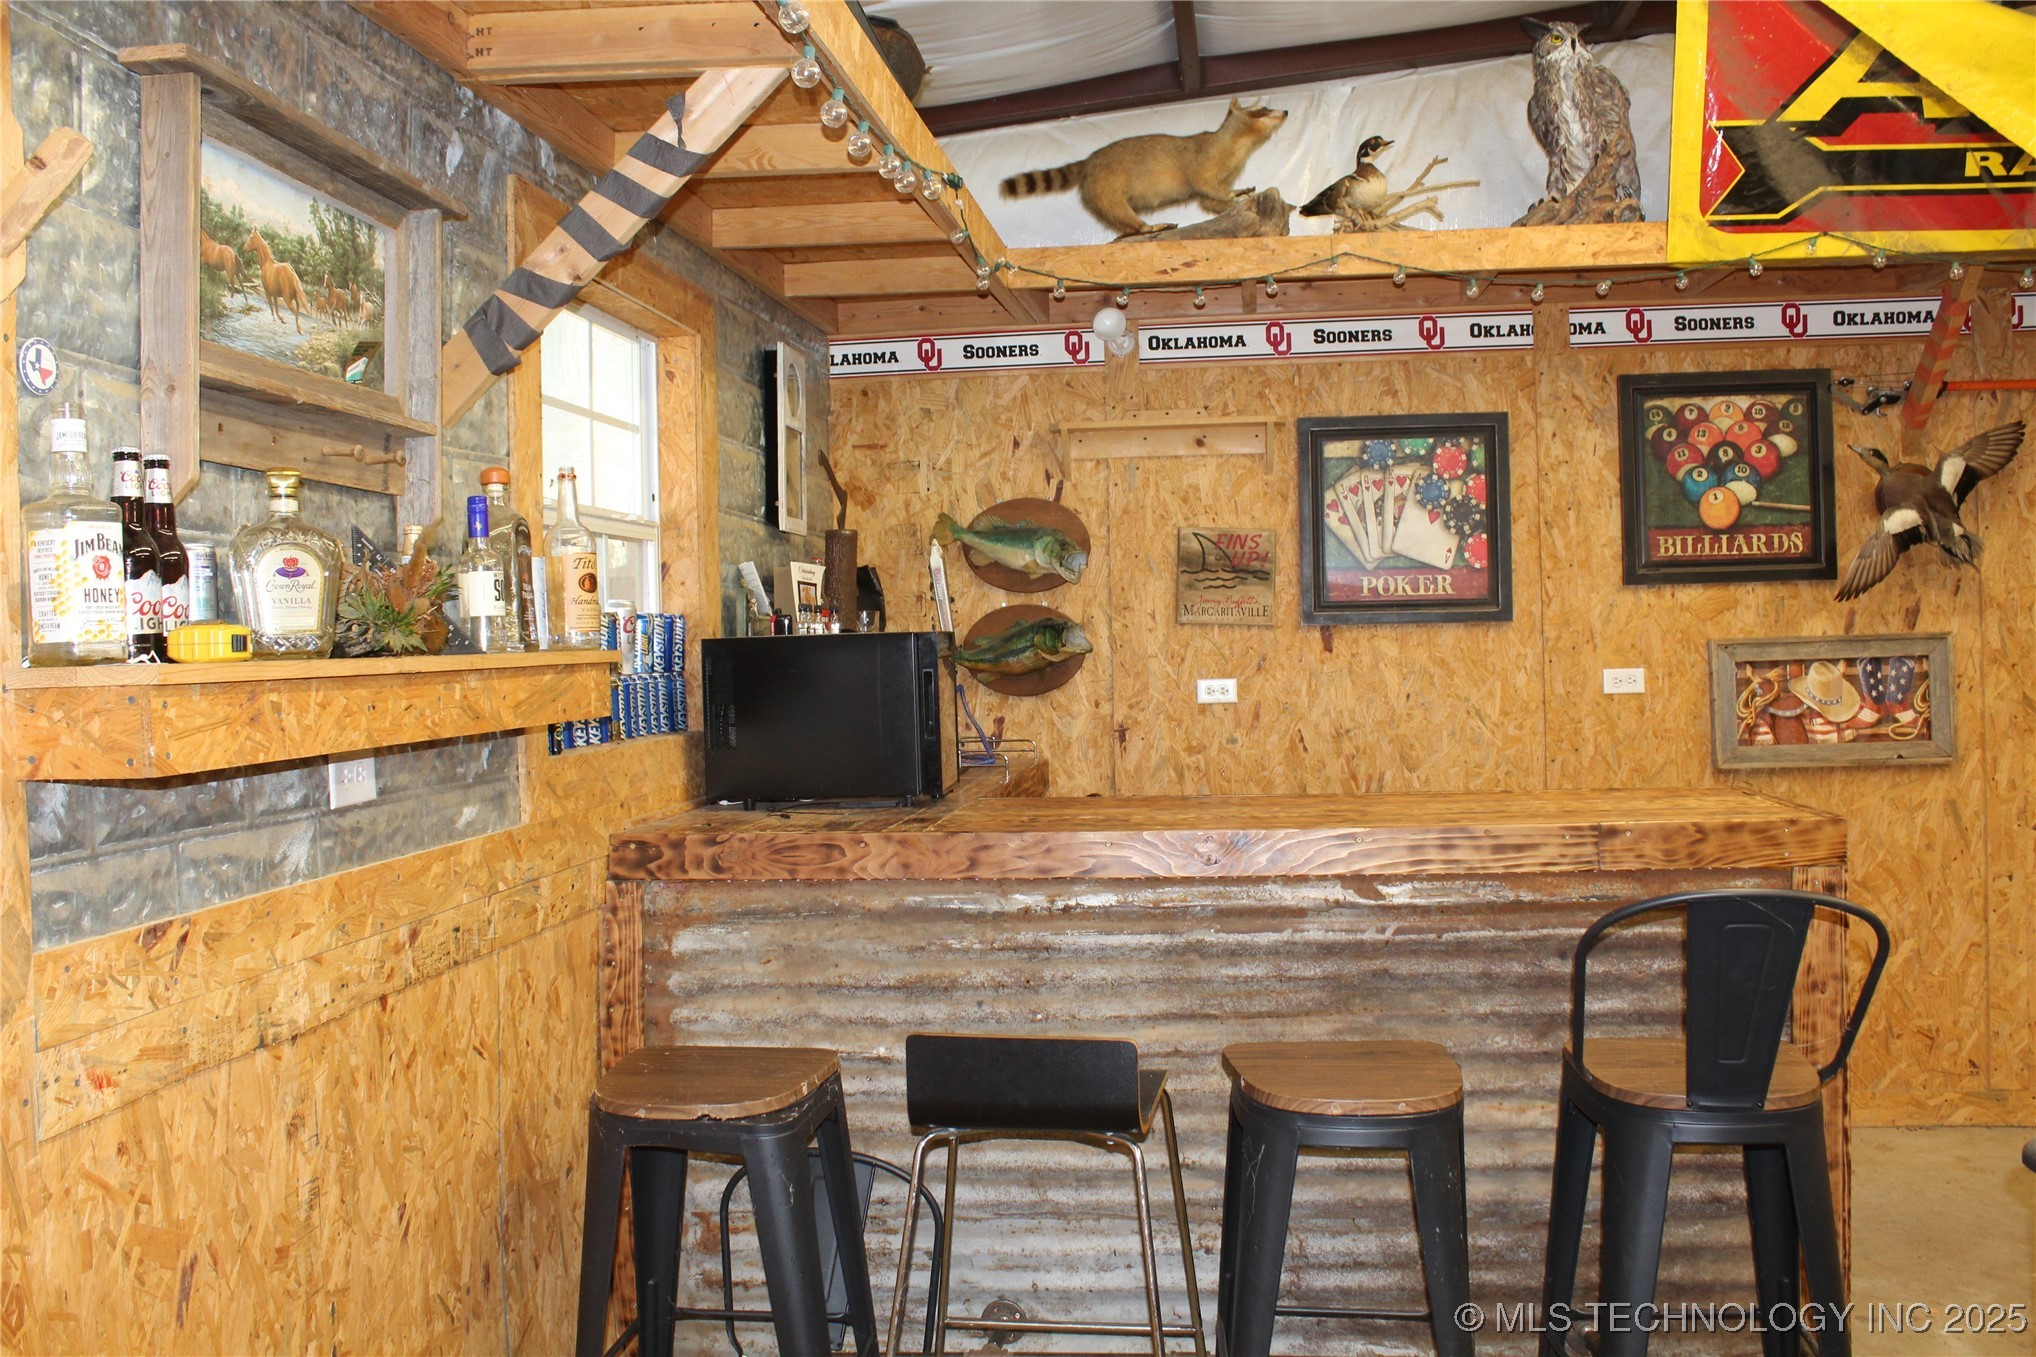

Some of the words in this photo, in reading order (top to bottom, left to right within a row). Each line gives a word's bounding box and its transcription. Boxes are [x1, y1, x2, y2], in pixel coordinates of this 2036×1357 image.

[1625, 308, 1652, 343] OU
[1674, 315, 1755, 331] SOONERS
[1781, 302, 1808, 338] OU
[1833, 309, 1936, 326] OKLAHOMA
[1148, 334, 1247, 350] OKLAHOMA
[1265, 321, 1292, 356] OU
[1313, 328, 1393, 344] SOONERS
[1419, 315, 1445, 350] OU
[1470, 322, 1534, 338] OKLAH
[830, 351, 899, 366] LAHOMA
[917, 337, 942, 371] OU
[963, 343, 1039, 360] SOONERS
[1064, 330, 1090, 364] OU
[121, 470, 141, 482] Coo
[1388, 468, 1394, 479] K
[148, 478, 171, 490] Coo
[1340, 484, 1346, 495] J
[74, 538, 95, 561] JIM
[1214, 533, 1262, 551] FINS
[1656, 532, 1804, 557] BILLIARDS
[573, 557, 597, 569] Tito
[1231, 551, 1269, 568] UP!
[265, 579, 290, 592] Crown
[287, 579, 316, 593] Royal
[1360, 573, 1455, 597] POKER
[84, 588, 120, 603] HONEY
[271, 597, 312, 605] VANILLA
[131, 592, 161, 616] Coo
[162, 595, 189, 619] Coo
[1183, 604, 1269, 617] MARGARITAVILLE
[136, 618, 162, 630] IGH
